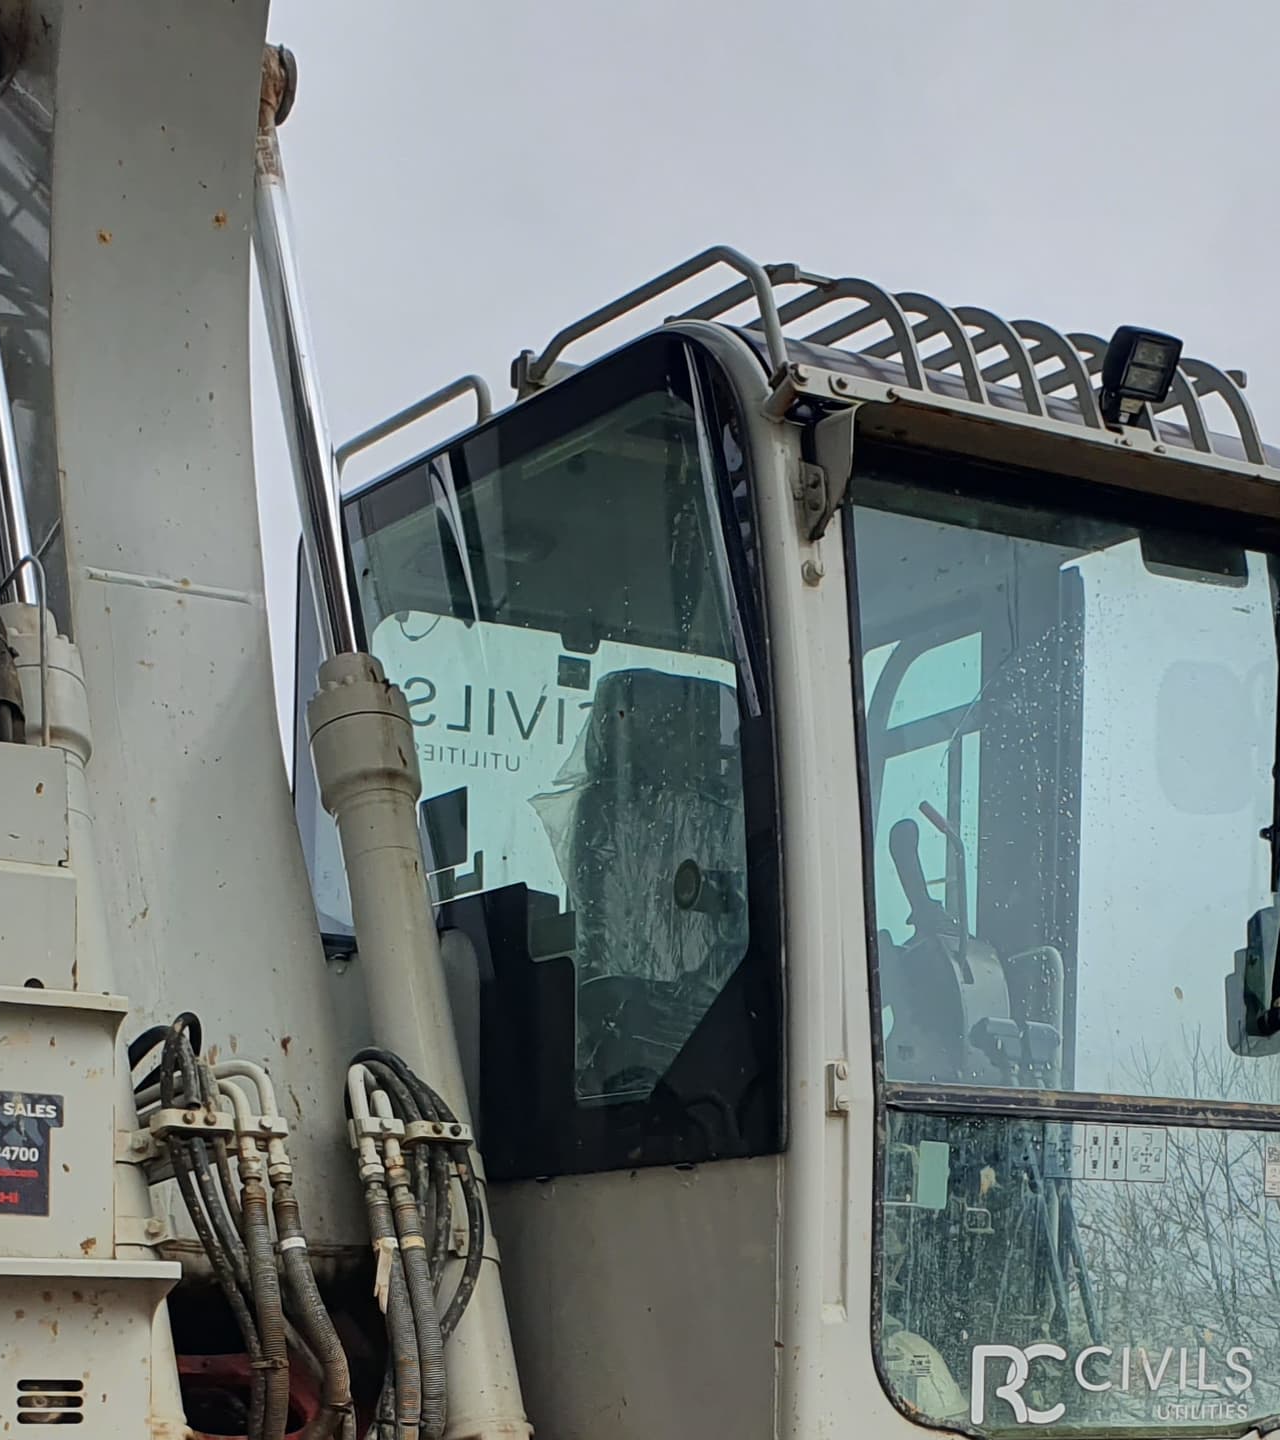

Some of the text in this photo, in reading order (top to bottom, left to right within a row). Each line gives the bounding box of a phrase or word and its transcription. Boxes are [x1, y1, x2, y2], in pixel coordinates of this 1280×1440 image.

[4, 1101, 58, 1118] SALES
[971, 1344, 1253, 1425] RC CIVILS
[1157, 1403, 1249, 1420] UTILITIES
